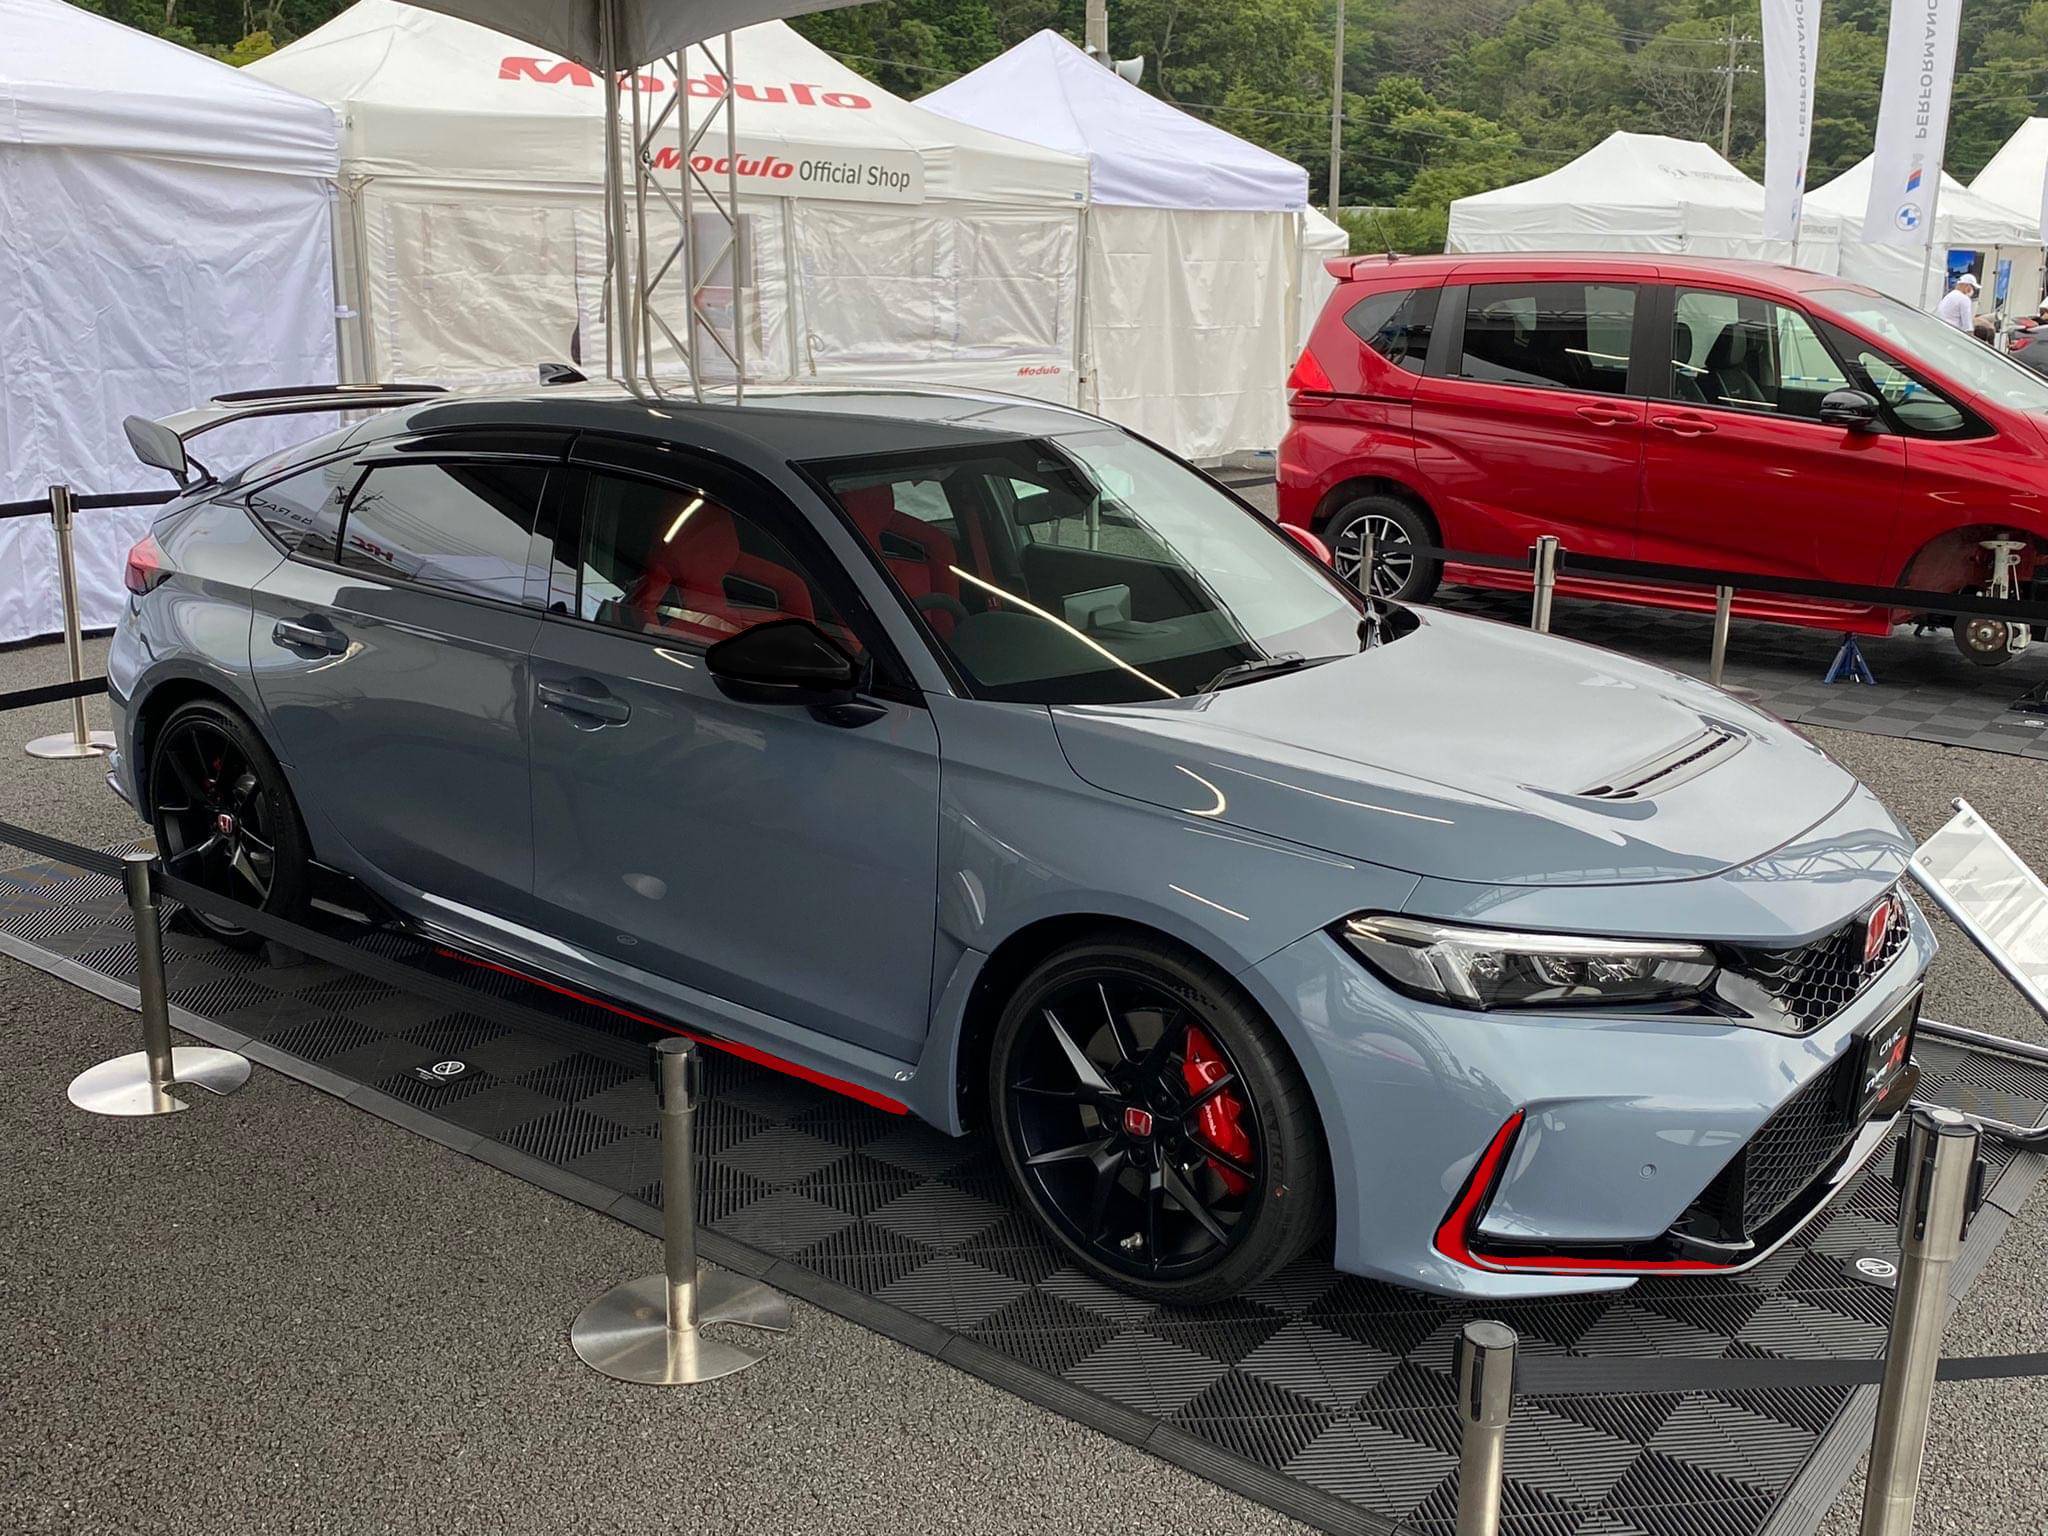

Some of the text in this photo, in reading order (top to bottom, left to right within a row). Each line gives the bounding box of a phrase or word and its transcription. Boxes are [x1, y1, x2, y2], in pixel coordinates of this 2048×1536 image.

[498, 56, 872, 109] Modulo
[652, 146, 910, 192] Modulo Official Shop
[1016, 365, 1061, 377] Modulo
